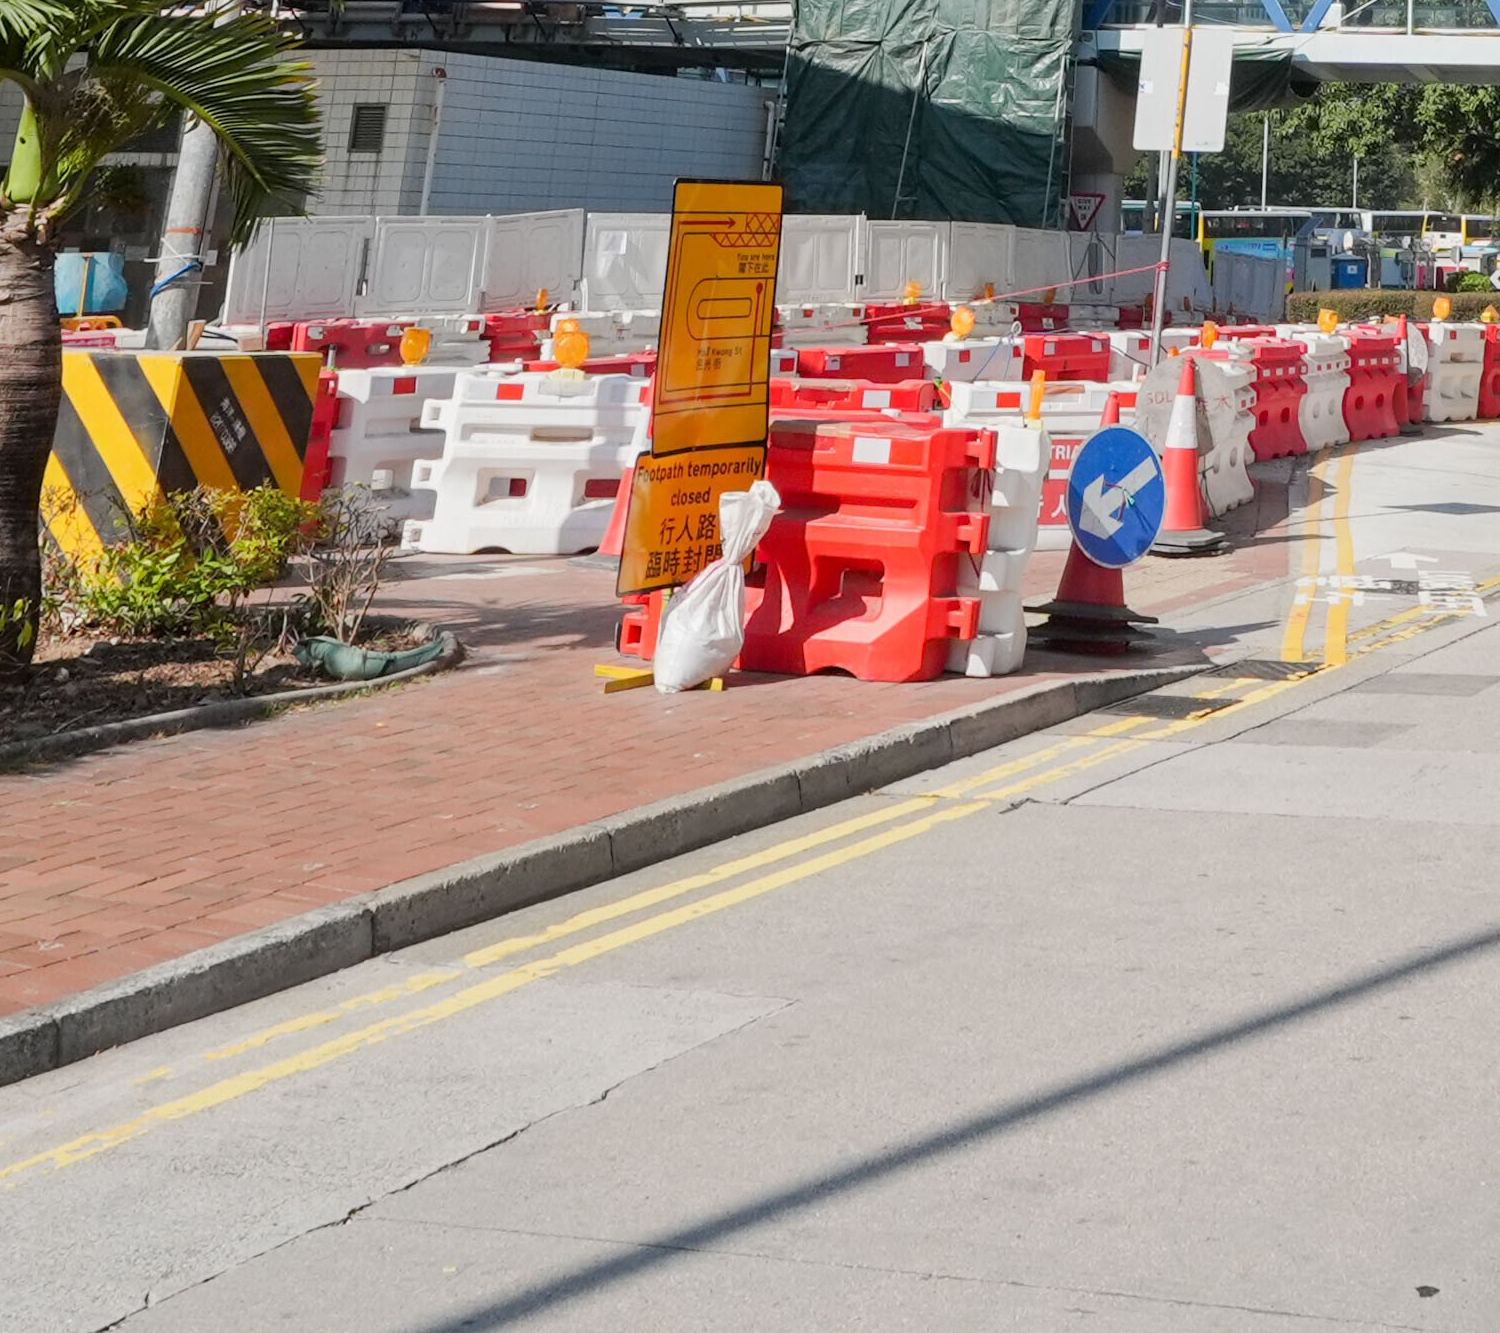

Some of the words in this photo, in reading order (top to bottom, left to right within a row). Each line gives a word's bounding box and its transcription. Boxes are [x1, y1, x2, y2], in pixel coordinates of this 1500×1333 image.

[637, 462, 685, 484] Footpath
[687, 456, 763, 478] temporarily
[670, 486, 712, 506] closed
[659, 512, 717, 546] 行人路
